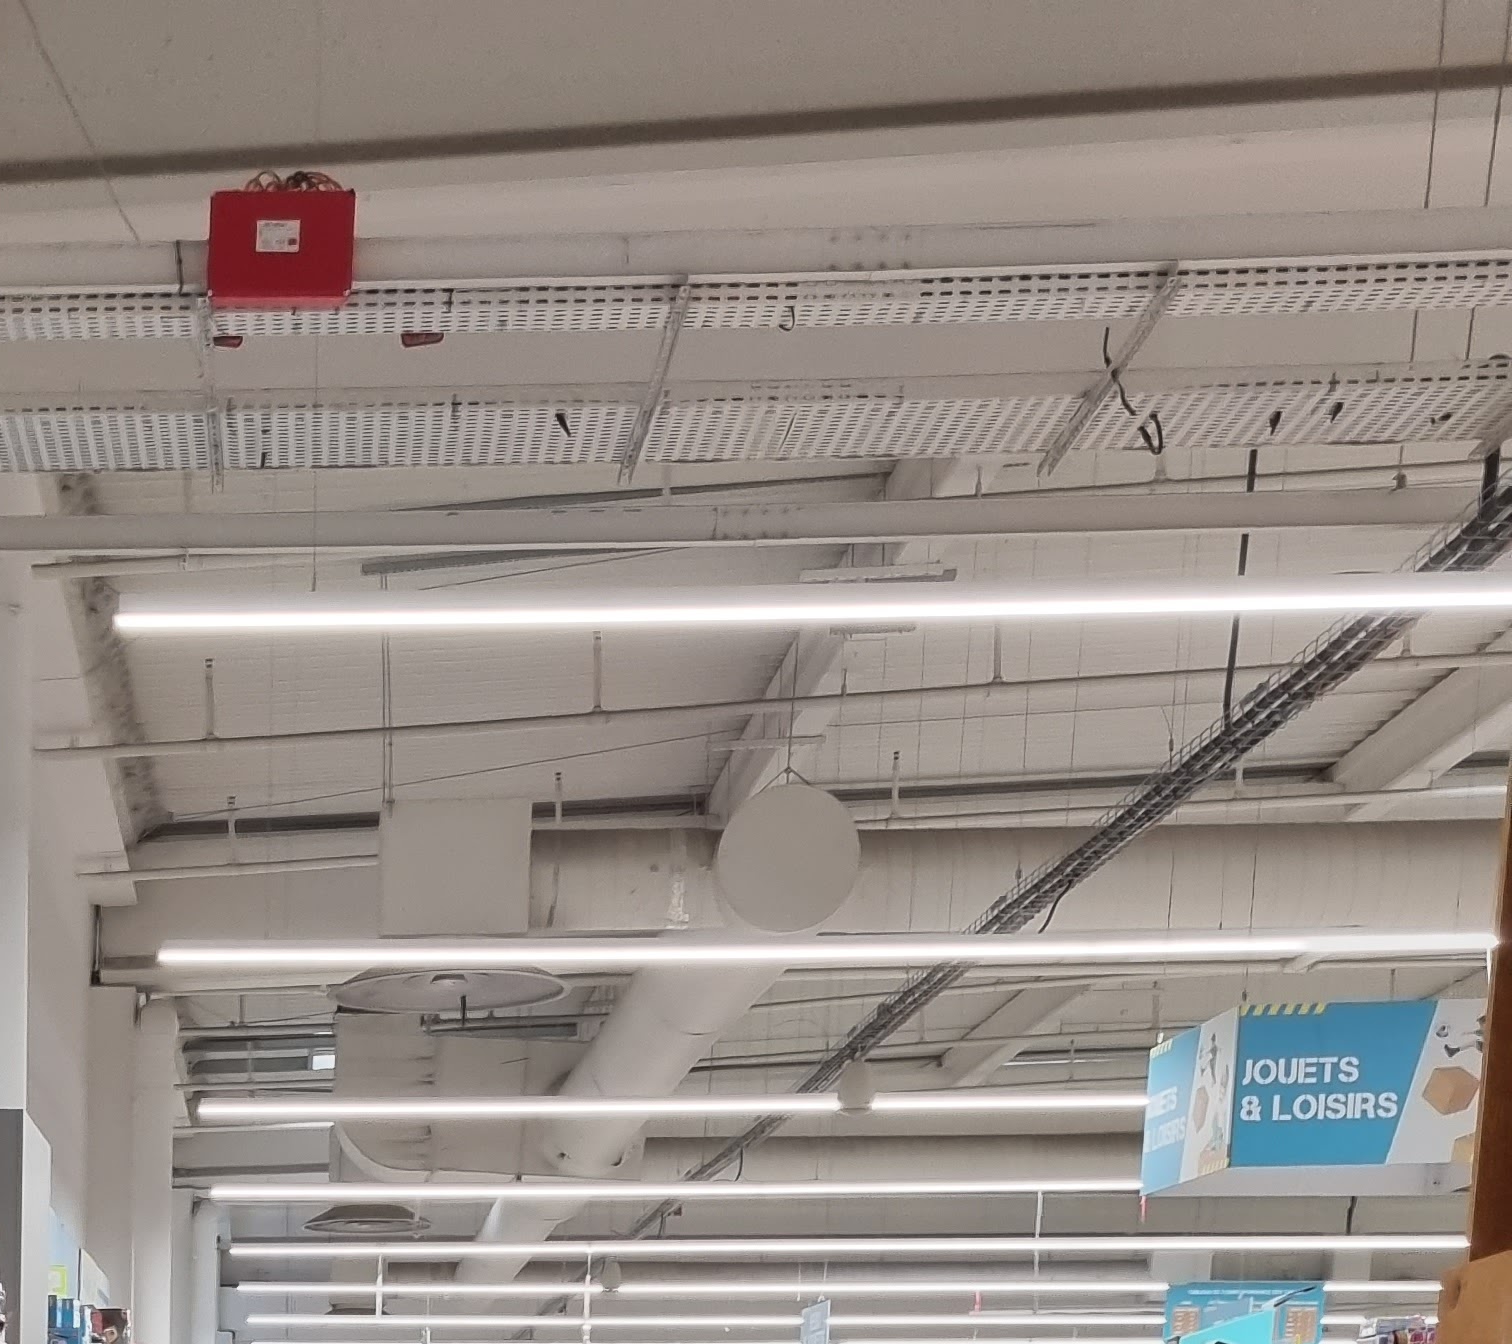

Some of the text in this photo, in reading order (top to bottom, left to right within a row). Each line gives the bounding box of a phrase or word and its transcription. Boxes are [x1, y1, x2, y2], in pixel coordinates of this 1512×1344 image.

[1241, 1056, 1360, 1086] JOUETS
[1239, 1092, 1399, 1121] & LOISIRS
